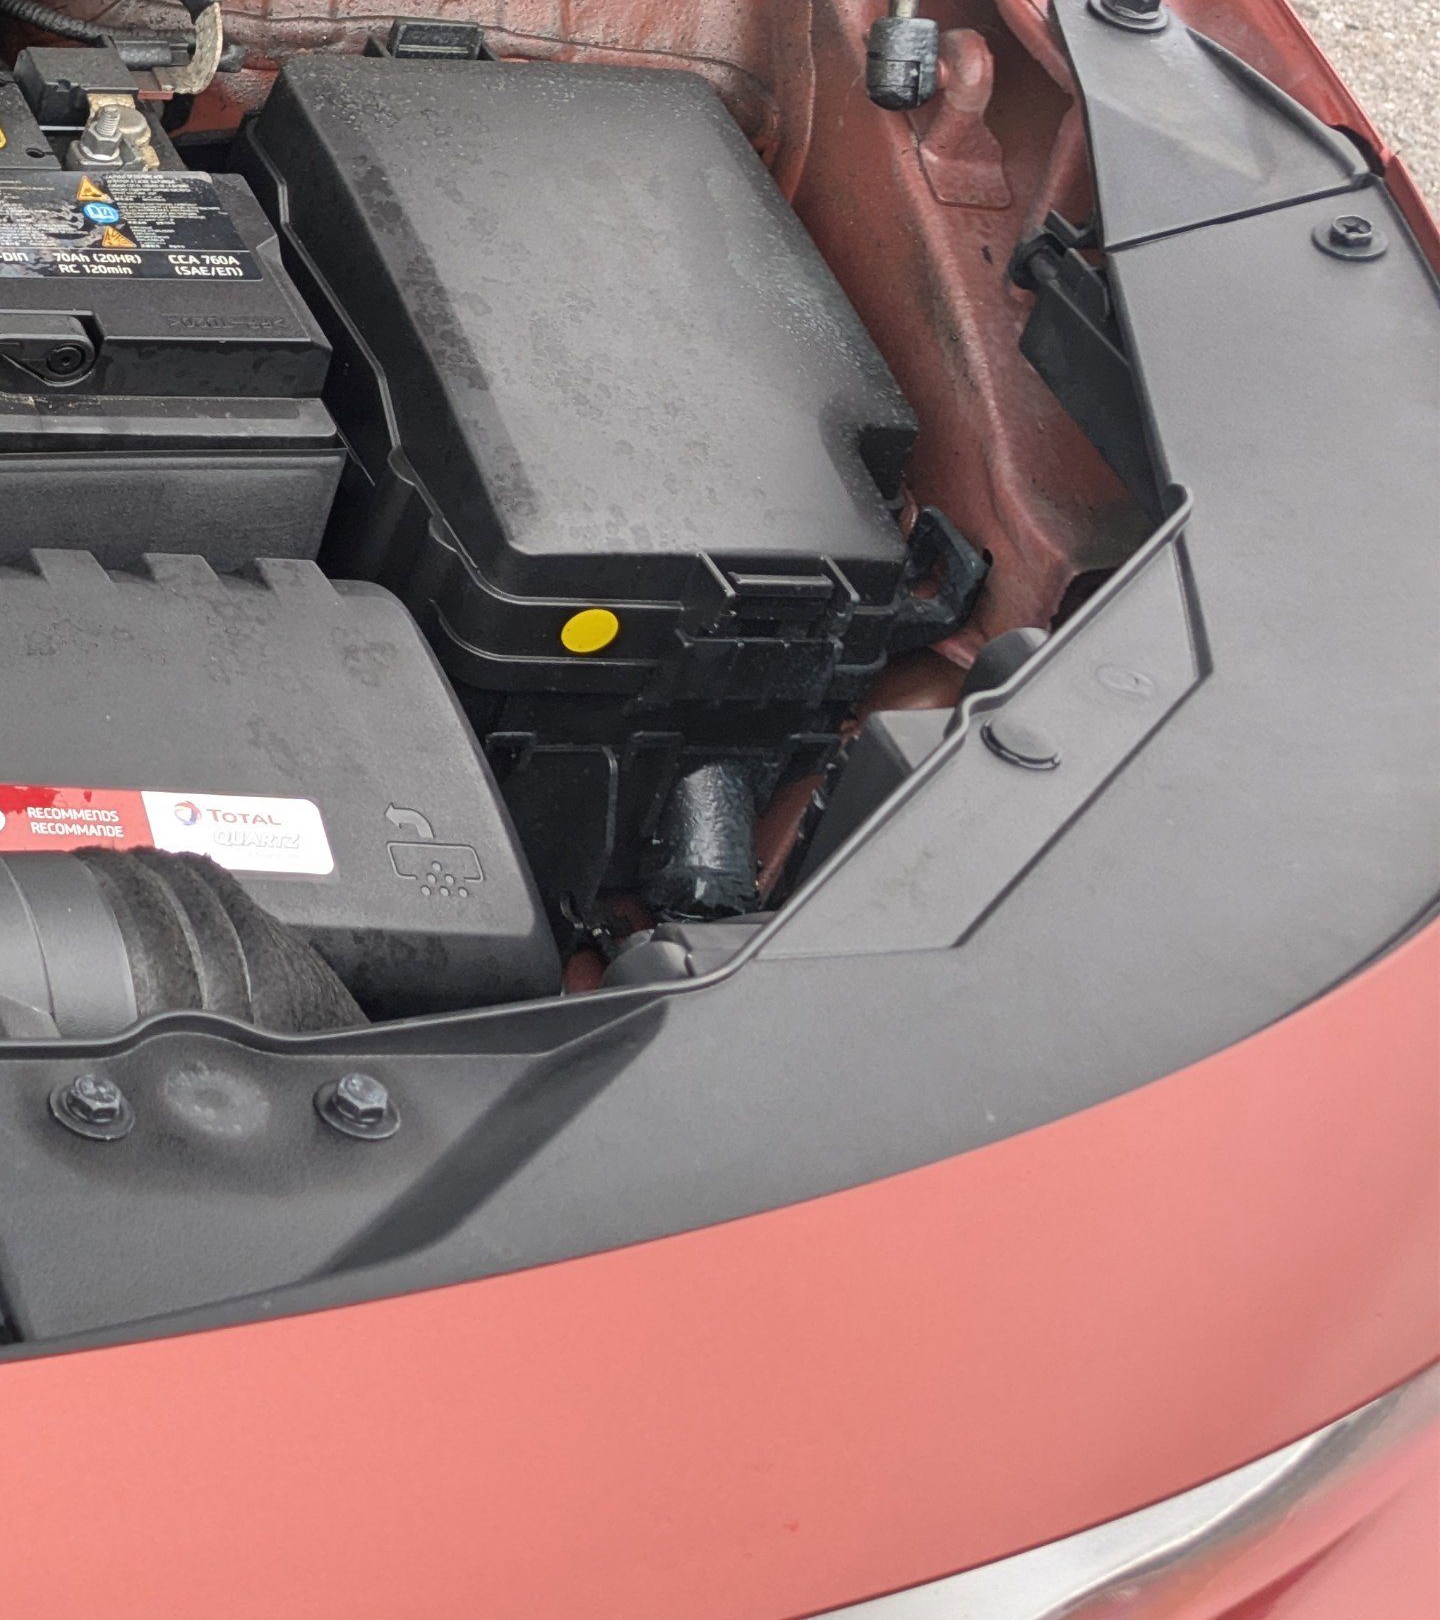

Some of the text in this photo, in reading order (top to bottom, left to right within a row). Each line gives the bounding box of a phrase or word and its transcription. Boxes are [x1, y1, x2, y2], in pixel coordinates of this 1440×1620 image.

[52, 252, 90, 263] 70Ah
[93, 253, 143, 264] (20HR)
[168, 254, 200, 265] CCA
[200, 255, 241, 266] 760A
[58, 264, 80, 274] RC
[82, 264, 133, 275] 120min
[174, 265, 244, 277] (SAE/EN)
[26, 806, 119, 823] RECOMMENDS
[30, 822, 301, 849] RECOMMANDE QUARTZ
